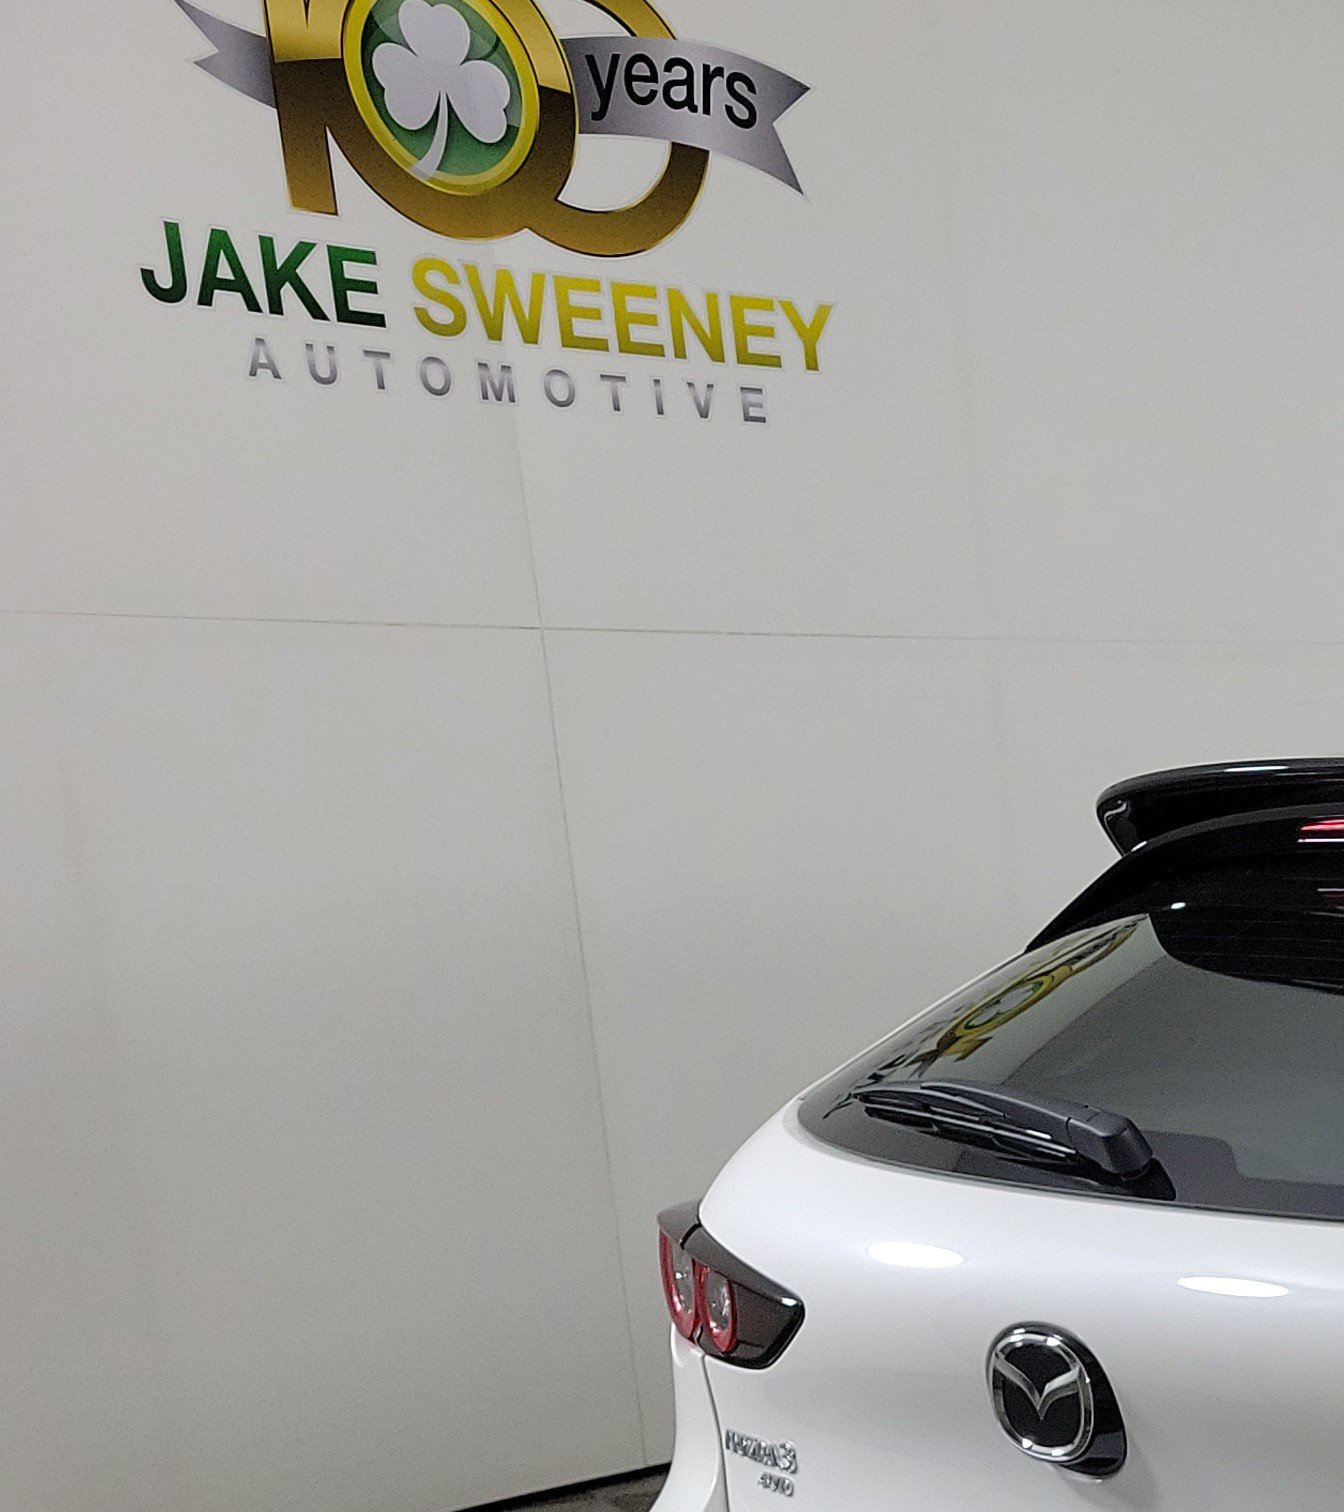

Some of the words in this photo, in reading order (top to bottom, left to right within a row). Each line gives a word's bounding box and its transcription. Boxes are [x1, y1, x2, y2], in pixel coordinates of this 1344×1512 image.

[585, 52, 759, 130] years
[140, 220, 387, 329] JAKE
[411, 257, 833, 372] SWEENEY
[247, 338, 768, 424] AUTOMOTIVE
